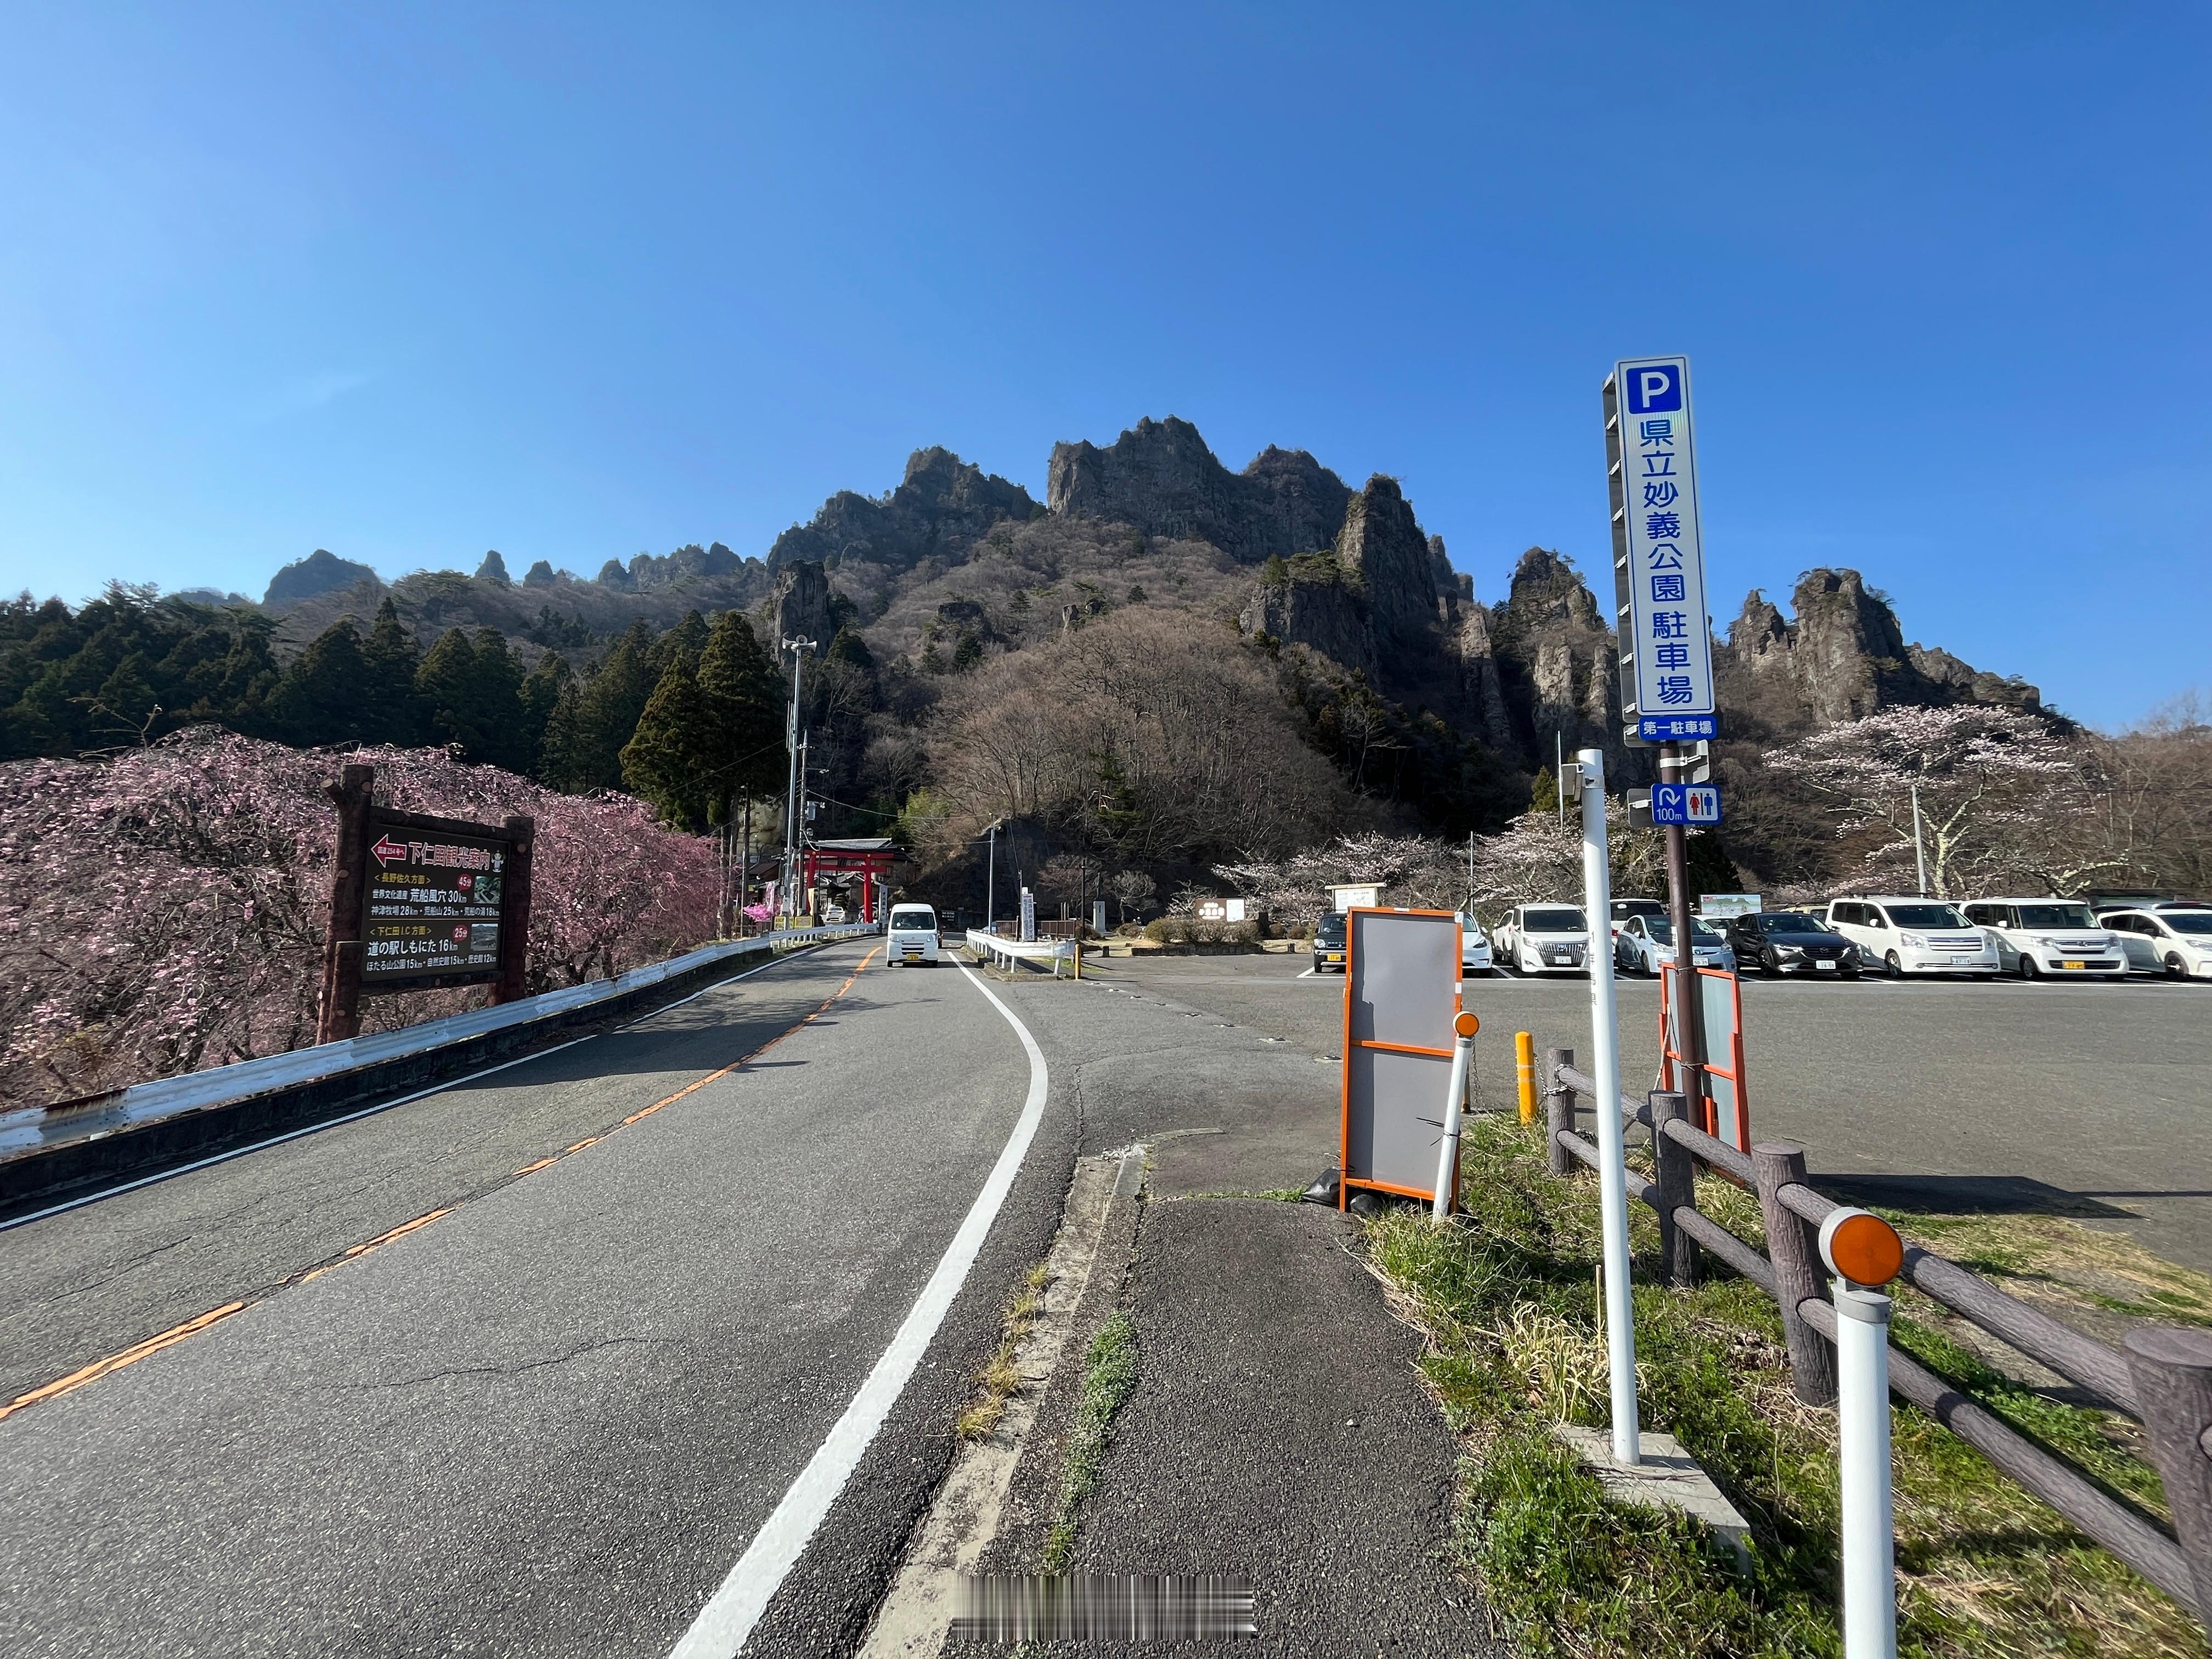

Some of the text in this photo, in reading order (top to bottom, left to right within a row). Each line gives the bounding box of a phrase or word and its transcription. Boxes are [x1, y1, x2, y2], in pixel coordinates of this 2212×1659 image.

[1640, 371, 1669, 408] P
[1640, 419, 1693, 704] 県立妙義公園駐車場
[1644, 720, 1712, 735] 第一駐車場
[1656, 808, 1682, 821] 100m
[409, 842, 490, 871] 下仁田観光案内
